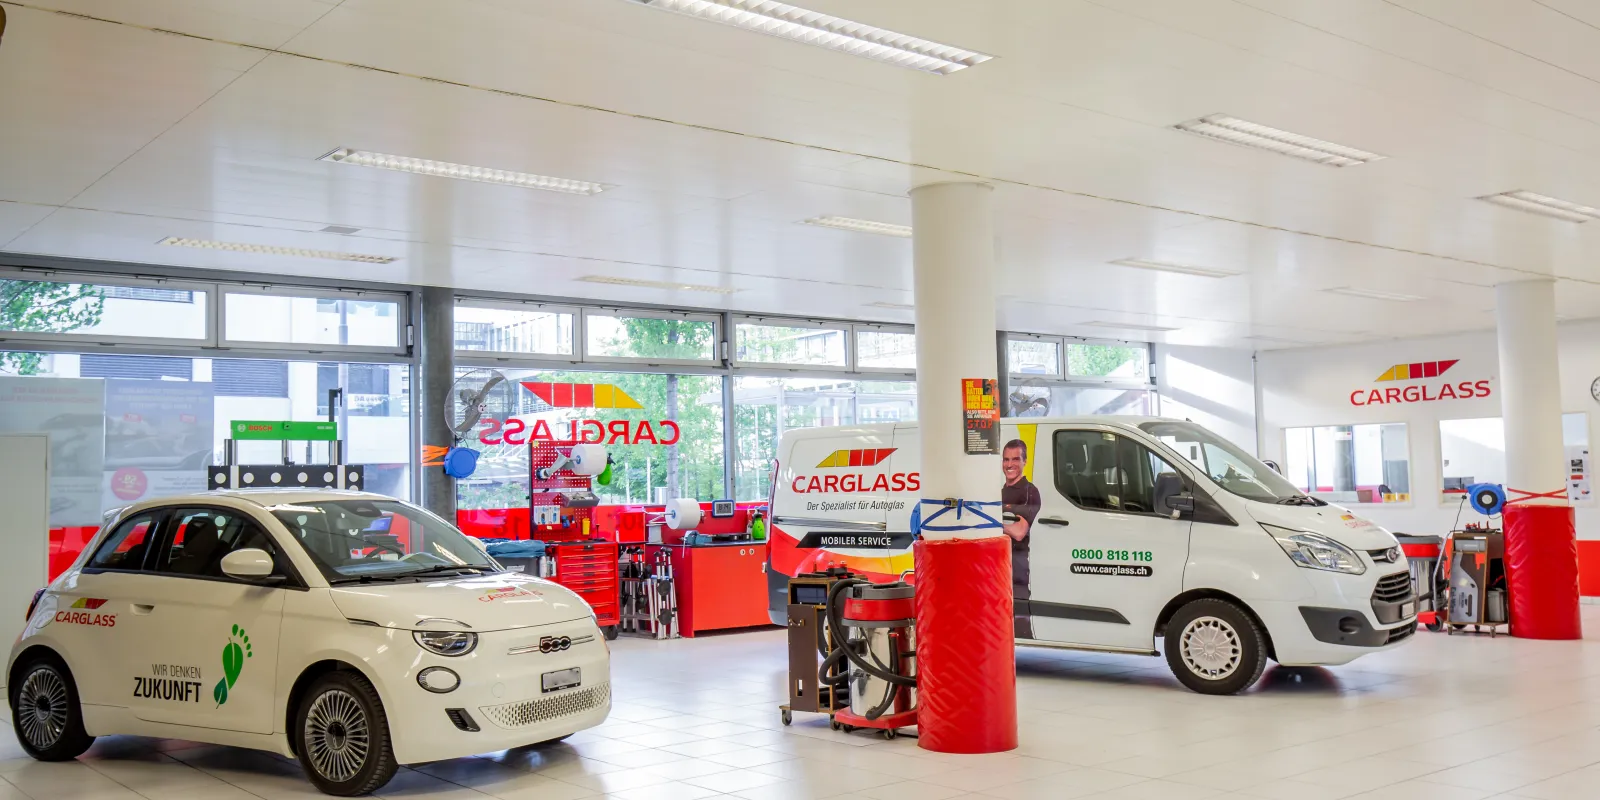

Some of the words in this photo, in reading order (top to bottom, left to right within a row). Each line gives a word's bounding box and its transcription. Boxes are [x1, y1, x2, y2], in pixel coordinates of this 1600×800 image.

[1350, 380, 1491, 406] CARGLASS
[248, 424, 272, 432] BOSCH
[792, 473, 920, 492] CARGLASS
[807, 501, 819, 510] Der
[821, 500, 856, 513] Spezialist
[858, 500, 869, 510] für
[870, 500, 905, 512] Autoglas
[821, 536, 855, 547] MOBILER
[858, 536, 892, 547] SERVICE
[1071, 548, 1103, 560] 0800
[1107, 549, 1129, 561] 818
[1132, 550, 1153, 562] 118
[1074, 565, 1147, 576] www.carglass.ch
[55, 611, 116, 627] CARGLASS
[539, 635, 571, 653] 500
[152, 664, 167, 676] WIR
[170, 665, 202, 679] DENKEN
[133, 676, 202, 703] ZUKUNFT
